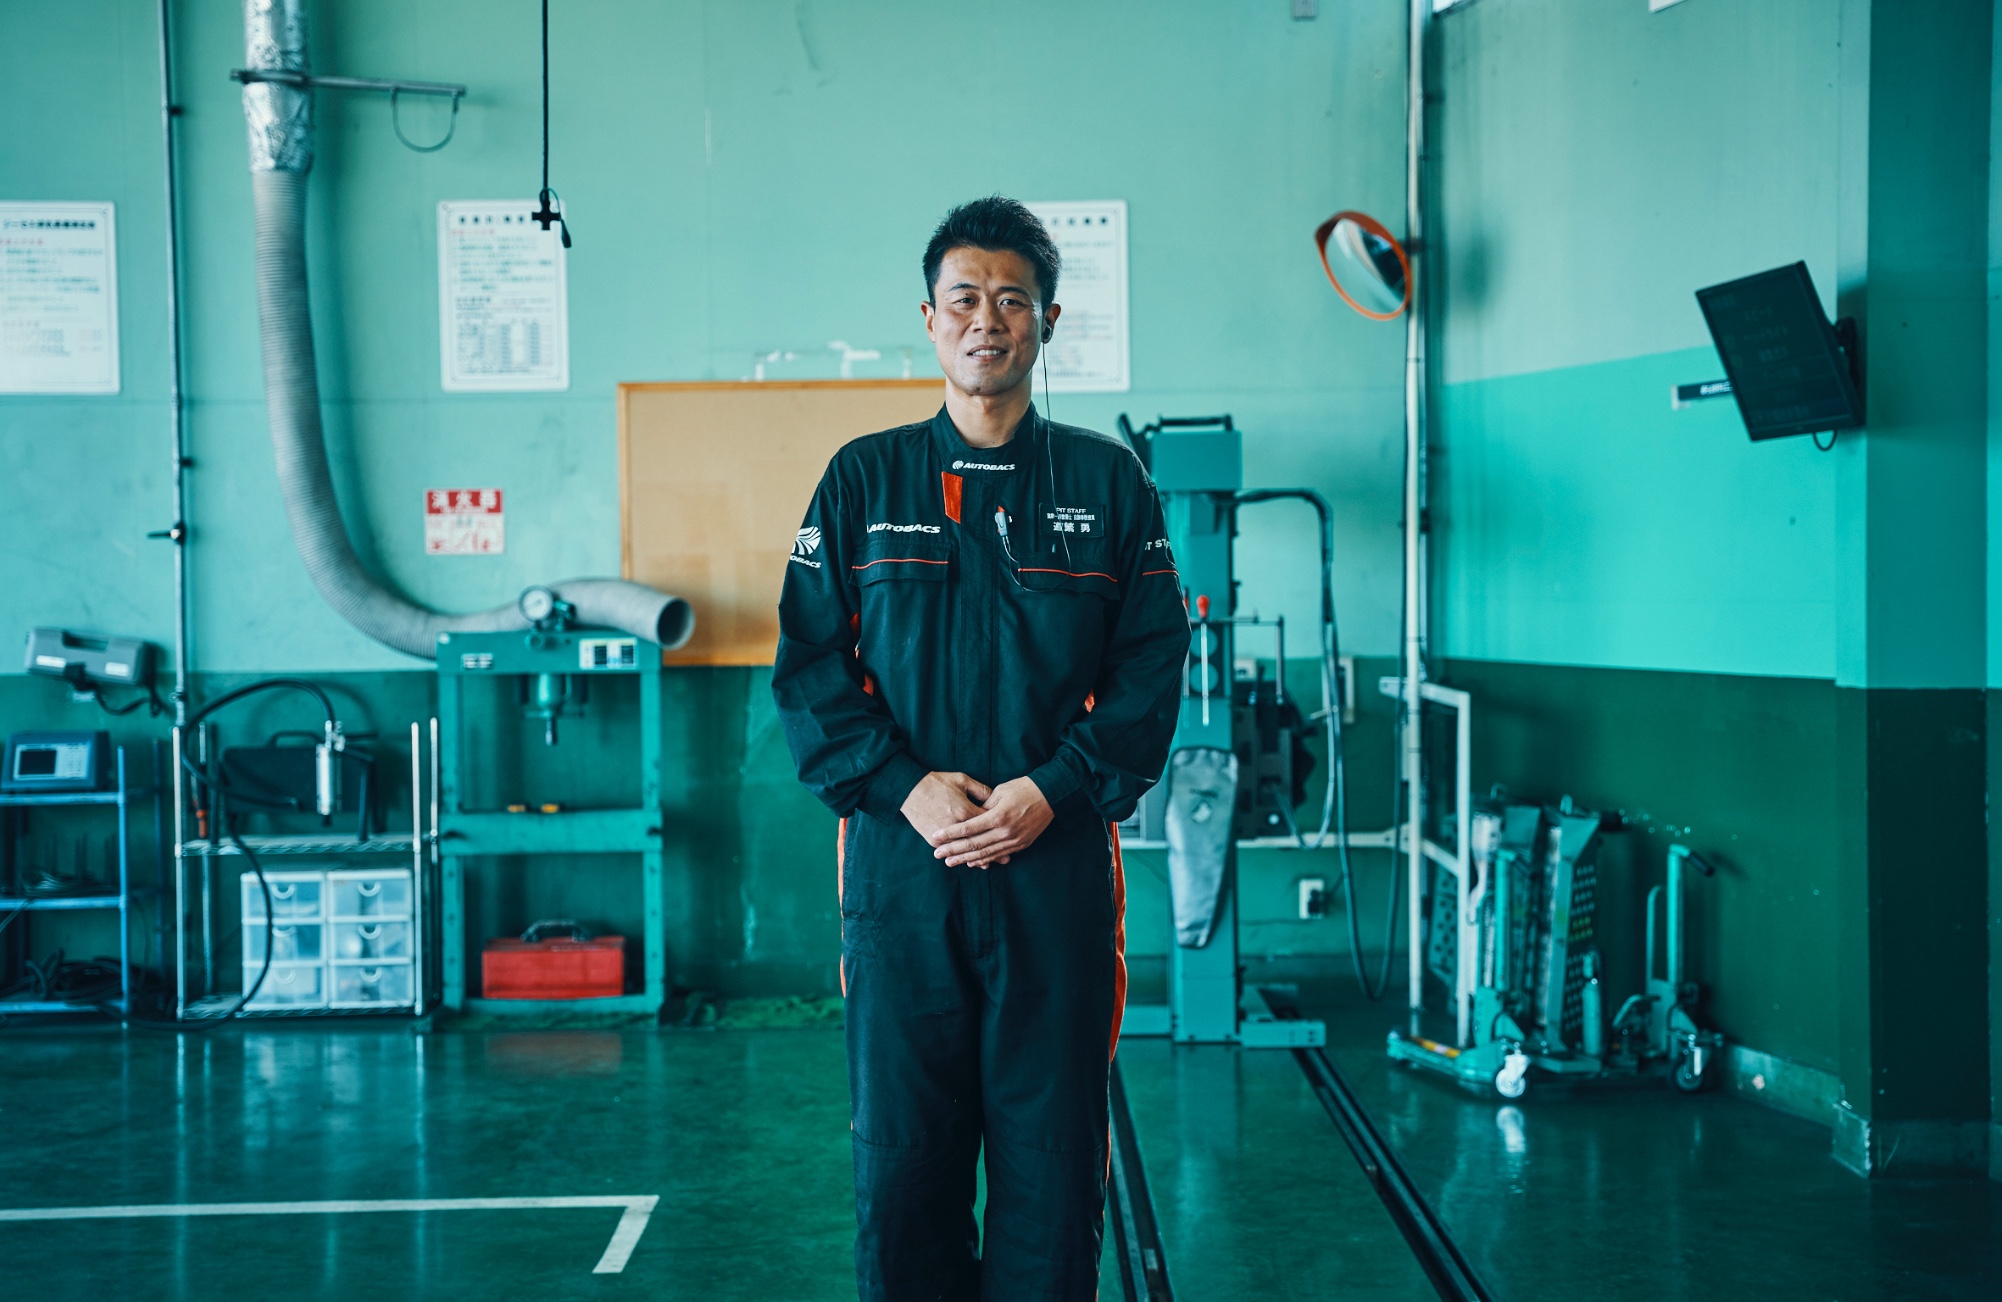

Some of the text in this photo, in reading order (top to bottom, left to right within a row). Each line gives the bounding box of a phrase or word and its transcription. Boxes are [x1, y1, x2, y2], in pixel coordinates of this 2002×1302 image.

[963, 463, 1015, 471] AUTOBACS
[868, 523, 941, 533] AUTOBACS
[790, 555, 821, 568] OBACS
